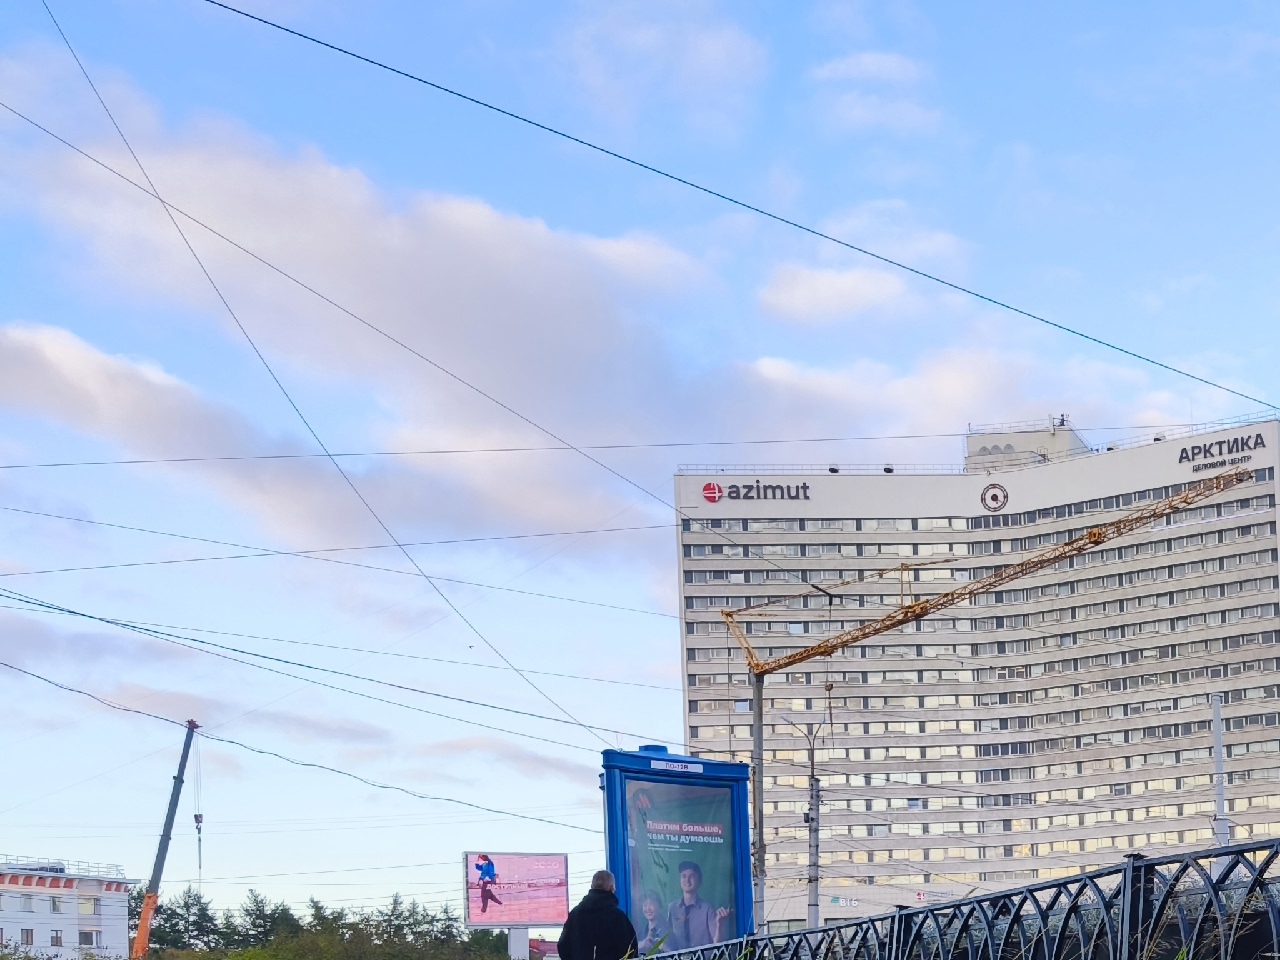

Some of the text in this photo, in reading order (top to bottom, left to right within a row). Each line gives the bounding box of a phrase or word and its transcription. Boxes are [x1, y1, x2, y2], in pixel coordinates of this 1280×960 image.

[1178, 433, 1266, 463] АРКТИКА
[1192, 454, 1252, 473] ДЕЛОВОЙ ЦЕНТР
[727, 479, 810, 500] azimut
[646, 820, 722, 834] Платим больше,
[647, 832, 724, 844] чем ты думаешь
